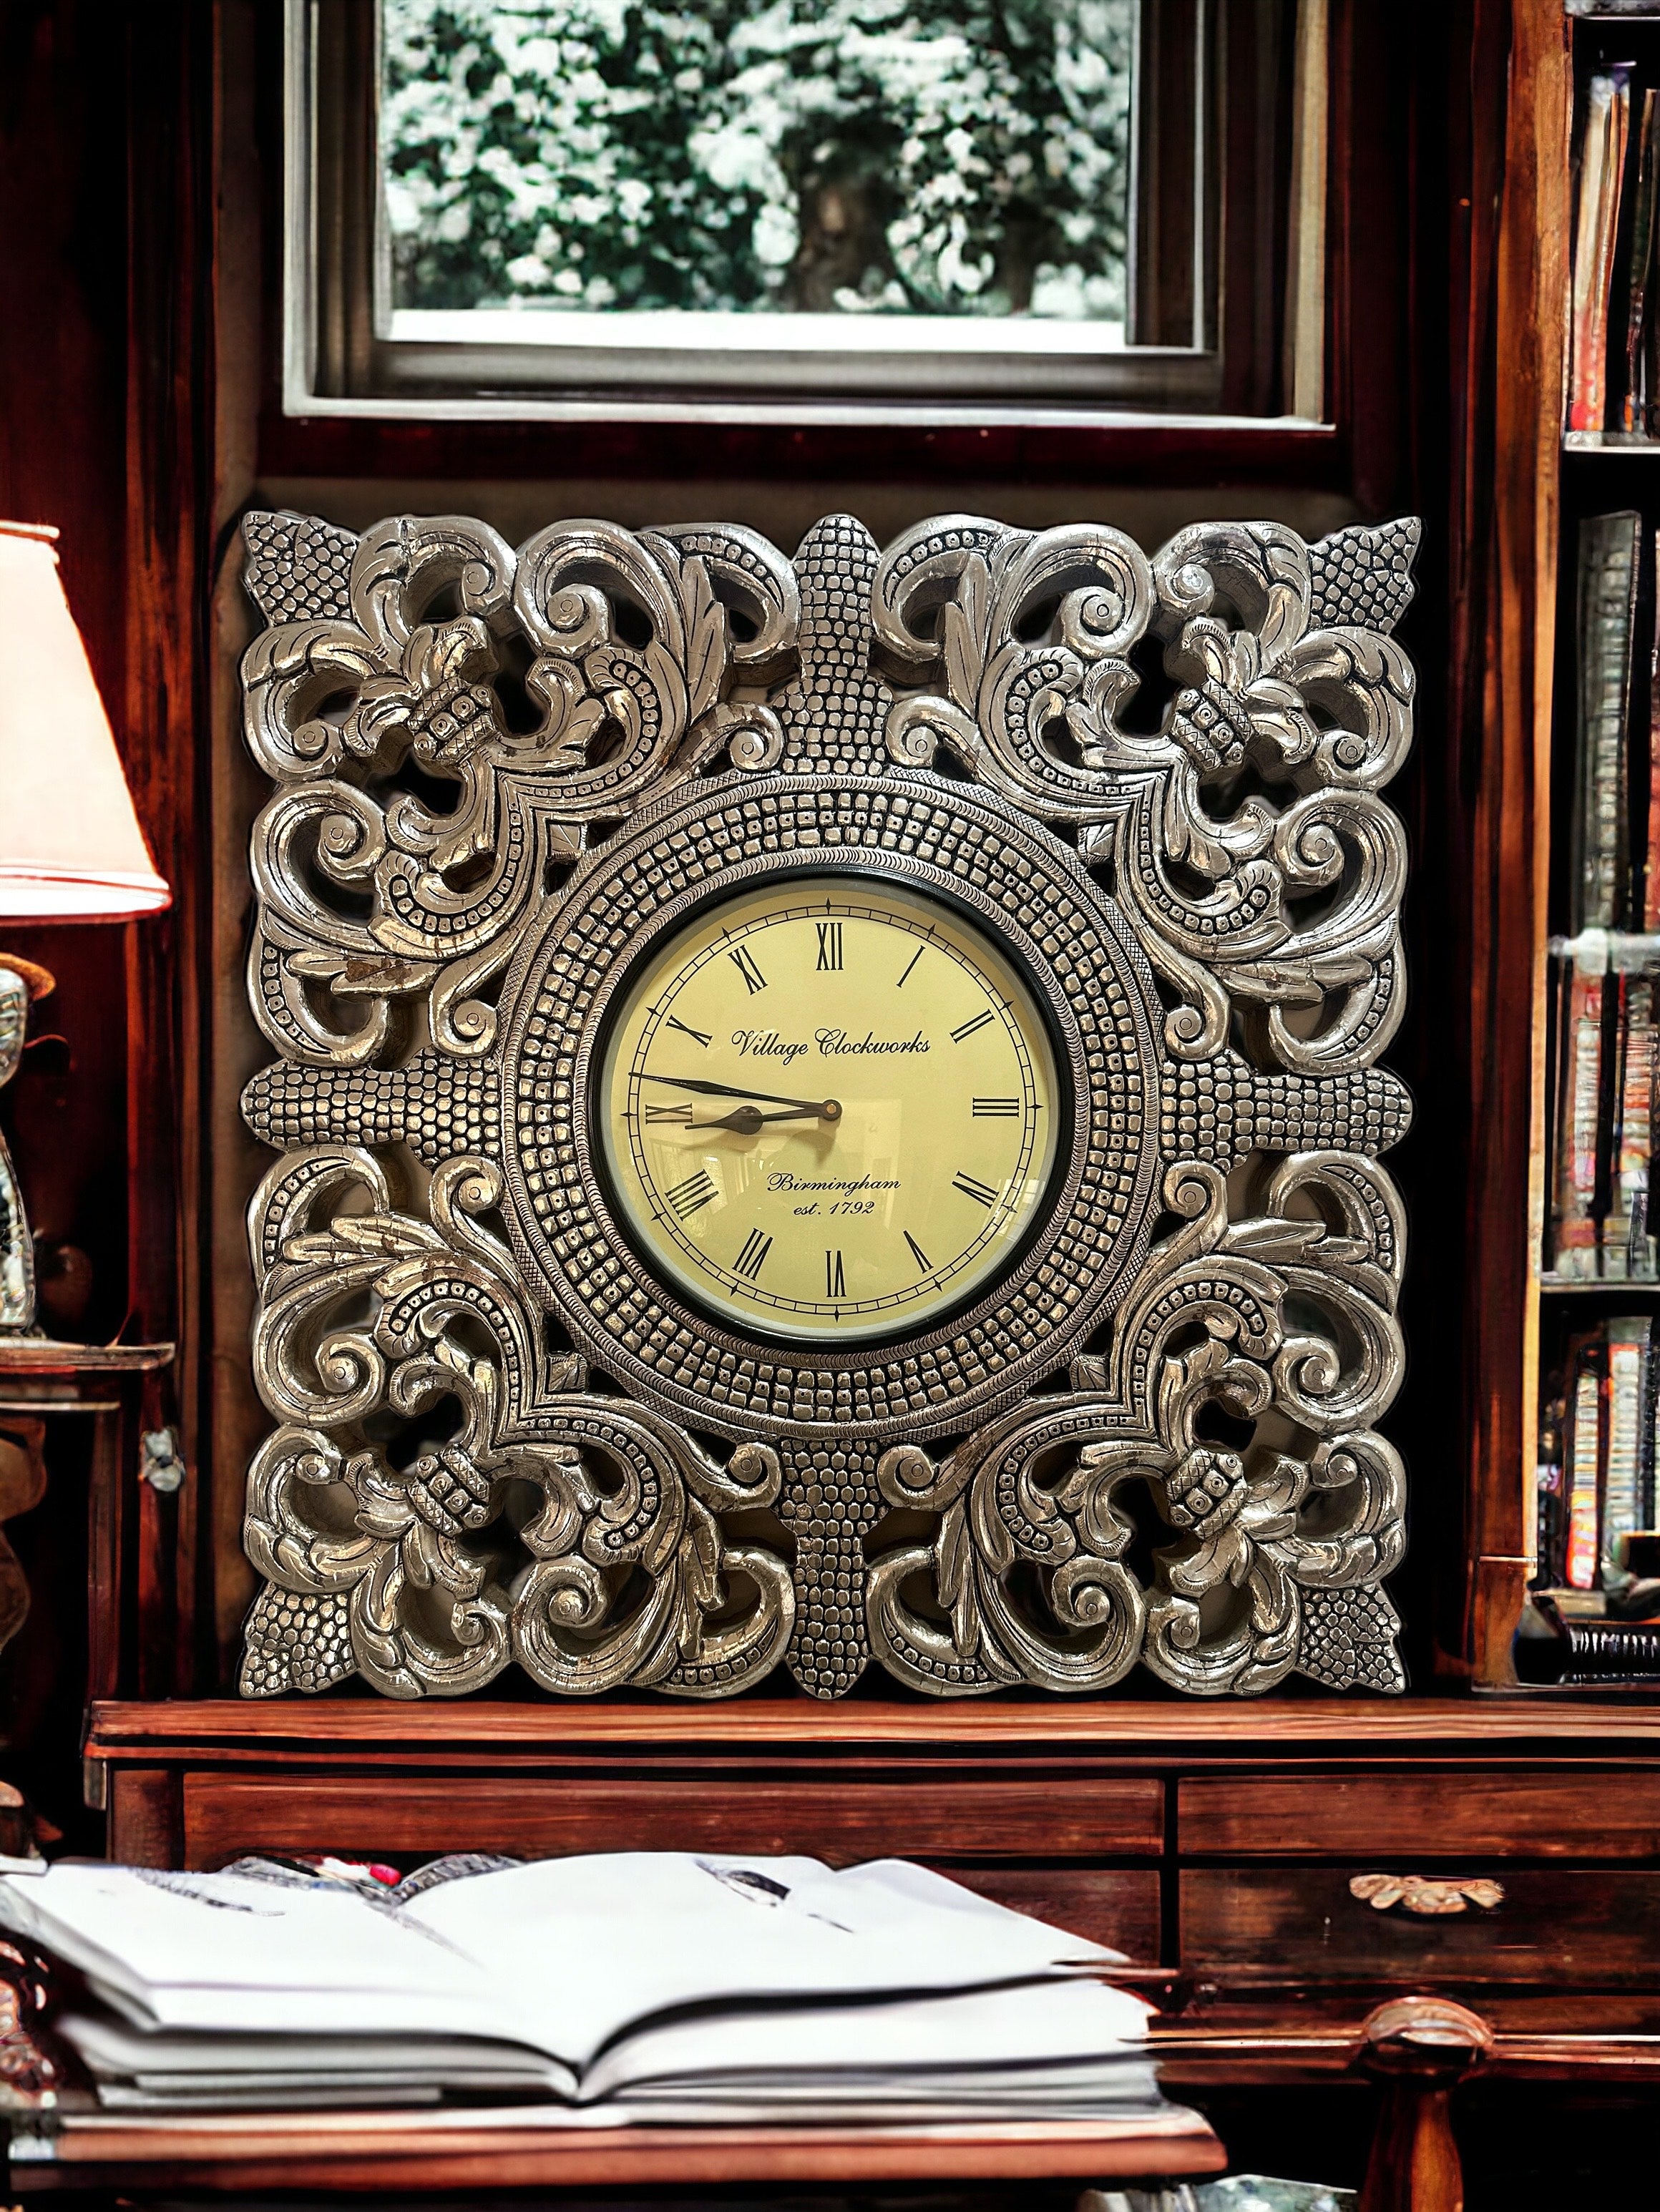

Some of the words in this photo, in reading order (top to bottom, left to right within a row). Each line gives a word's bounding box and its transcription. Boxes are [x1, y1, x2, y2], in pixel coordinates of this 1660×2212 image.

[815, 923, 844, 971] XII
[897, 945, 926, 988] I
[728, 944, 768, 995] XI
[665, 1014, 713, 1048] X
[949, 1009, 995, 1044] II
[731, 1030, 809, 1066] Village
[815, 1029, 930, 1057] Clockworks
[645, 1103, 693, 1125] IX
[972, 1097, 1019, 1117] III
[665, 1169, 719, 1222] VIII
[767, 1173, 902, 1198] Birmingham
[952, 1170, 1000, 1209] IV
[794, 1202, 821, 1215] est.
[829, 1201, 875, 1215] 1792
[732, 1228, 773, 1281] VII
[903, 1230, 934, 1274] V
[826, 1251, 846, 1297] VI
